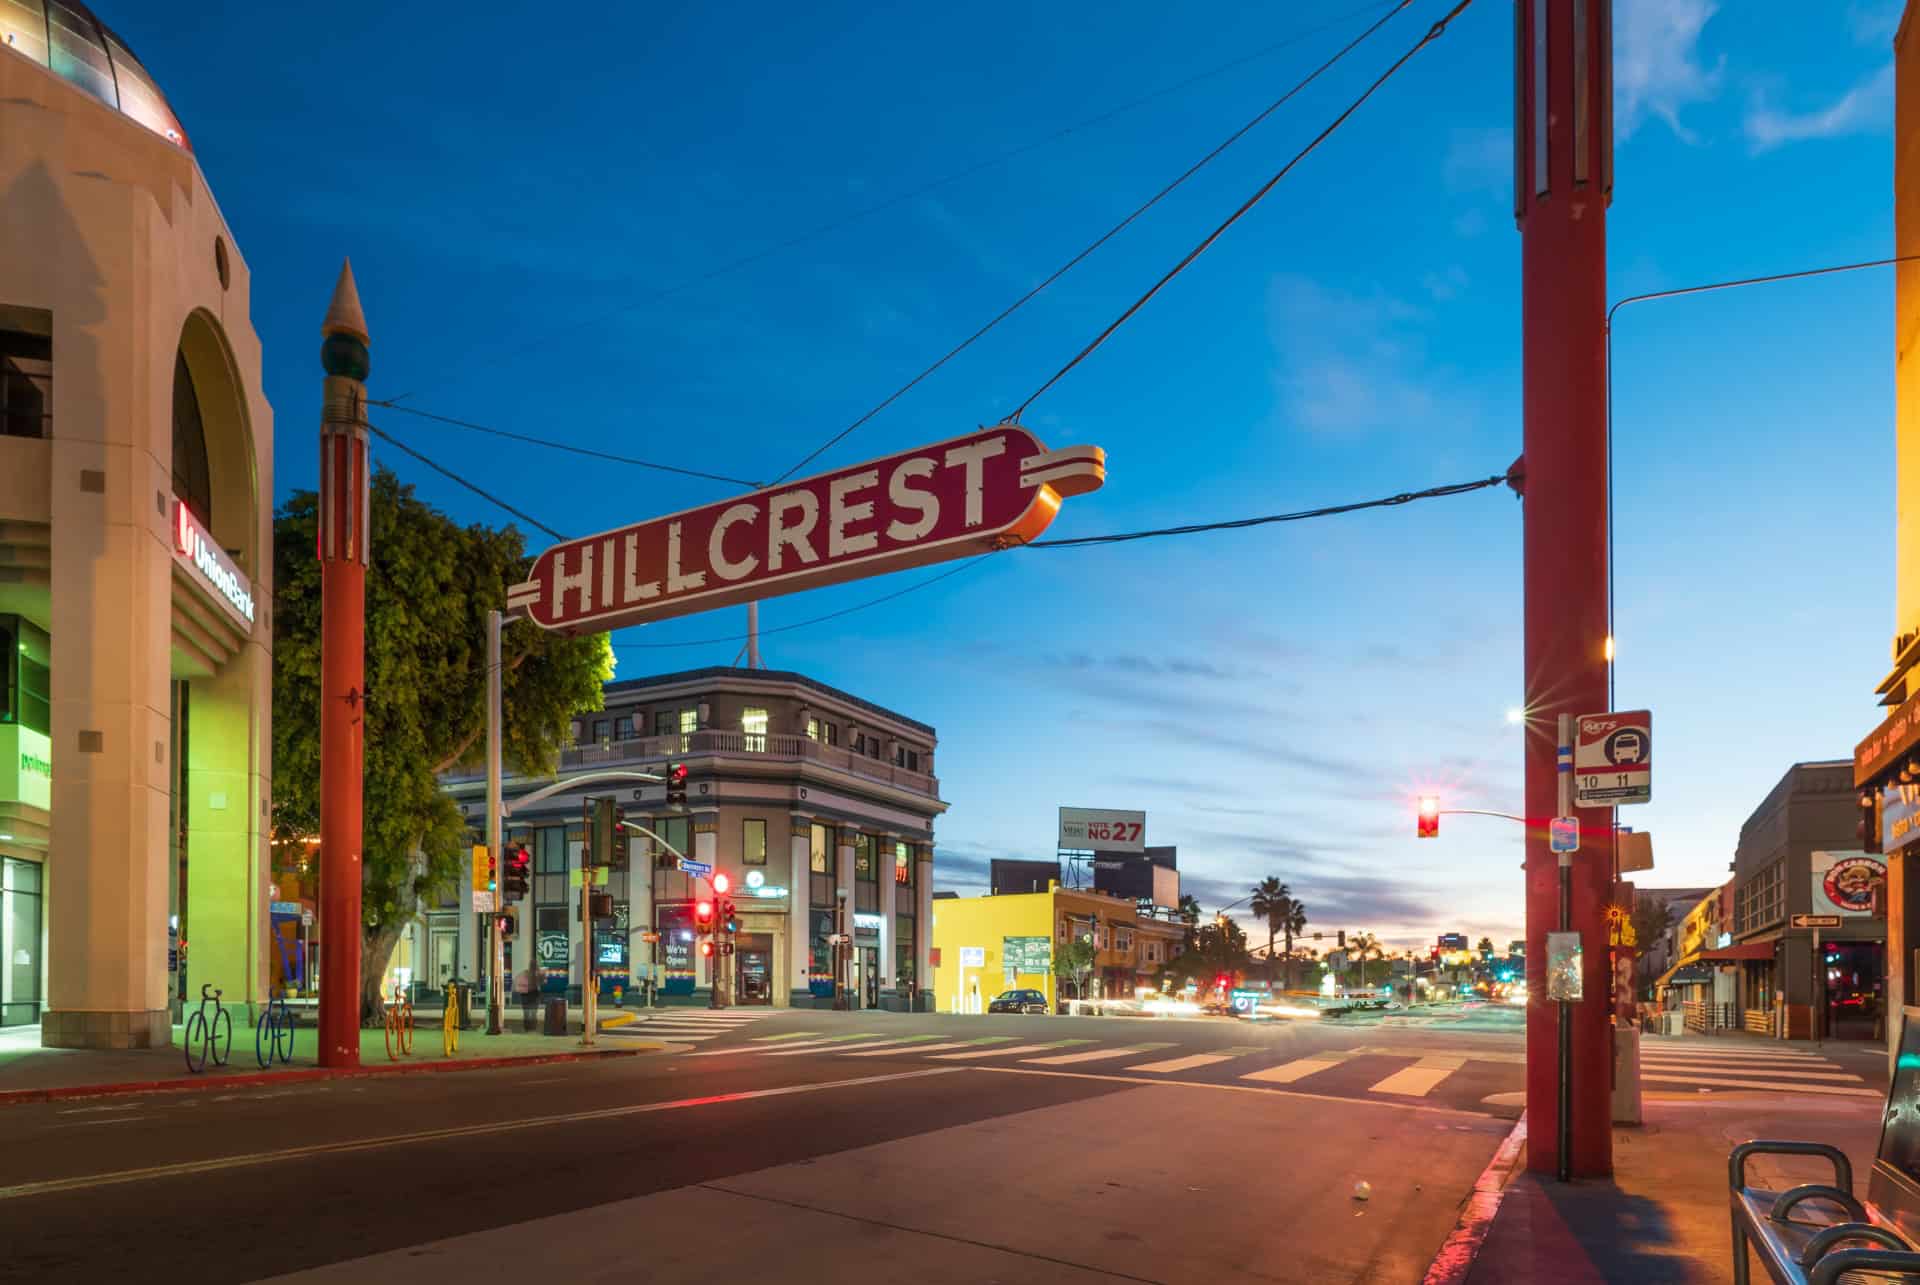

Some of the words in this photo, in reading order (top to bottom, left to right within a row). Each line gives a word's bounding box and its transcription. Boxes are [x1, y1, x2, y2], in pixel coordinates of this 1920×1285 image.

[551, 436, 1006, 619] HILLCREST
[1583, 775, 1599, 788] 10
[1617, 774, 1629, 787] 11
[1088, 829, 1111, 841] NO
[1112, 821, 1142, 842] 27
[665, 944, 688, 955] We're
